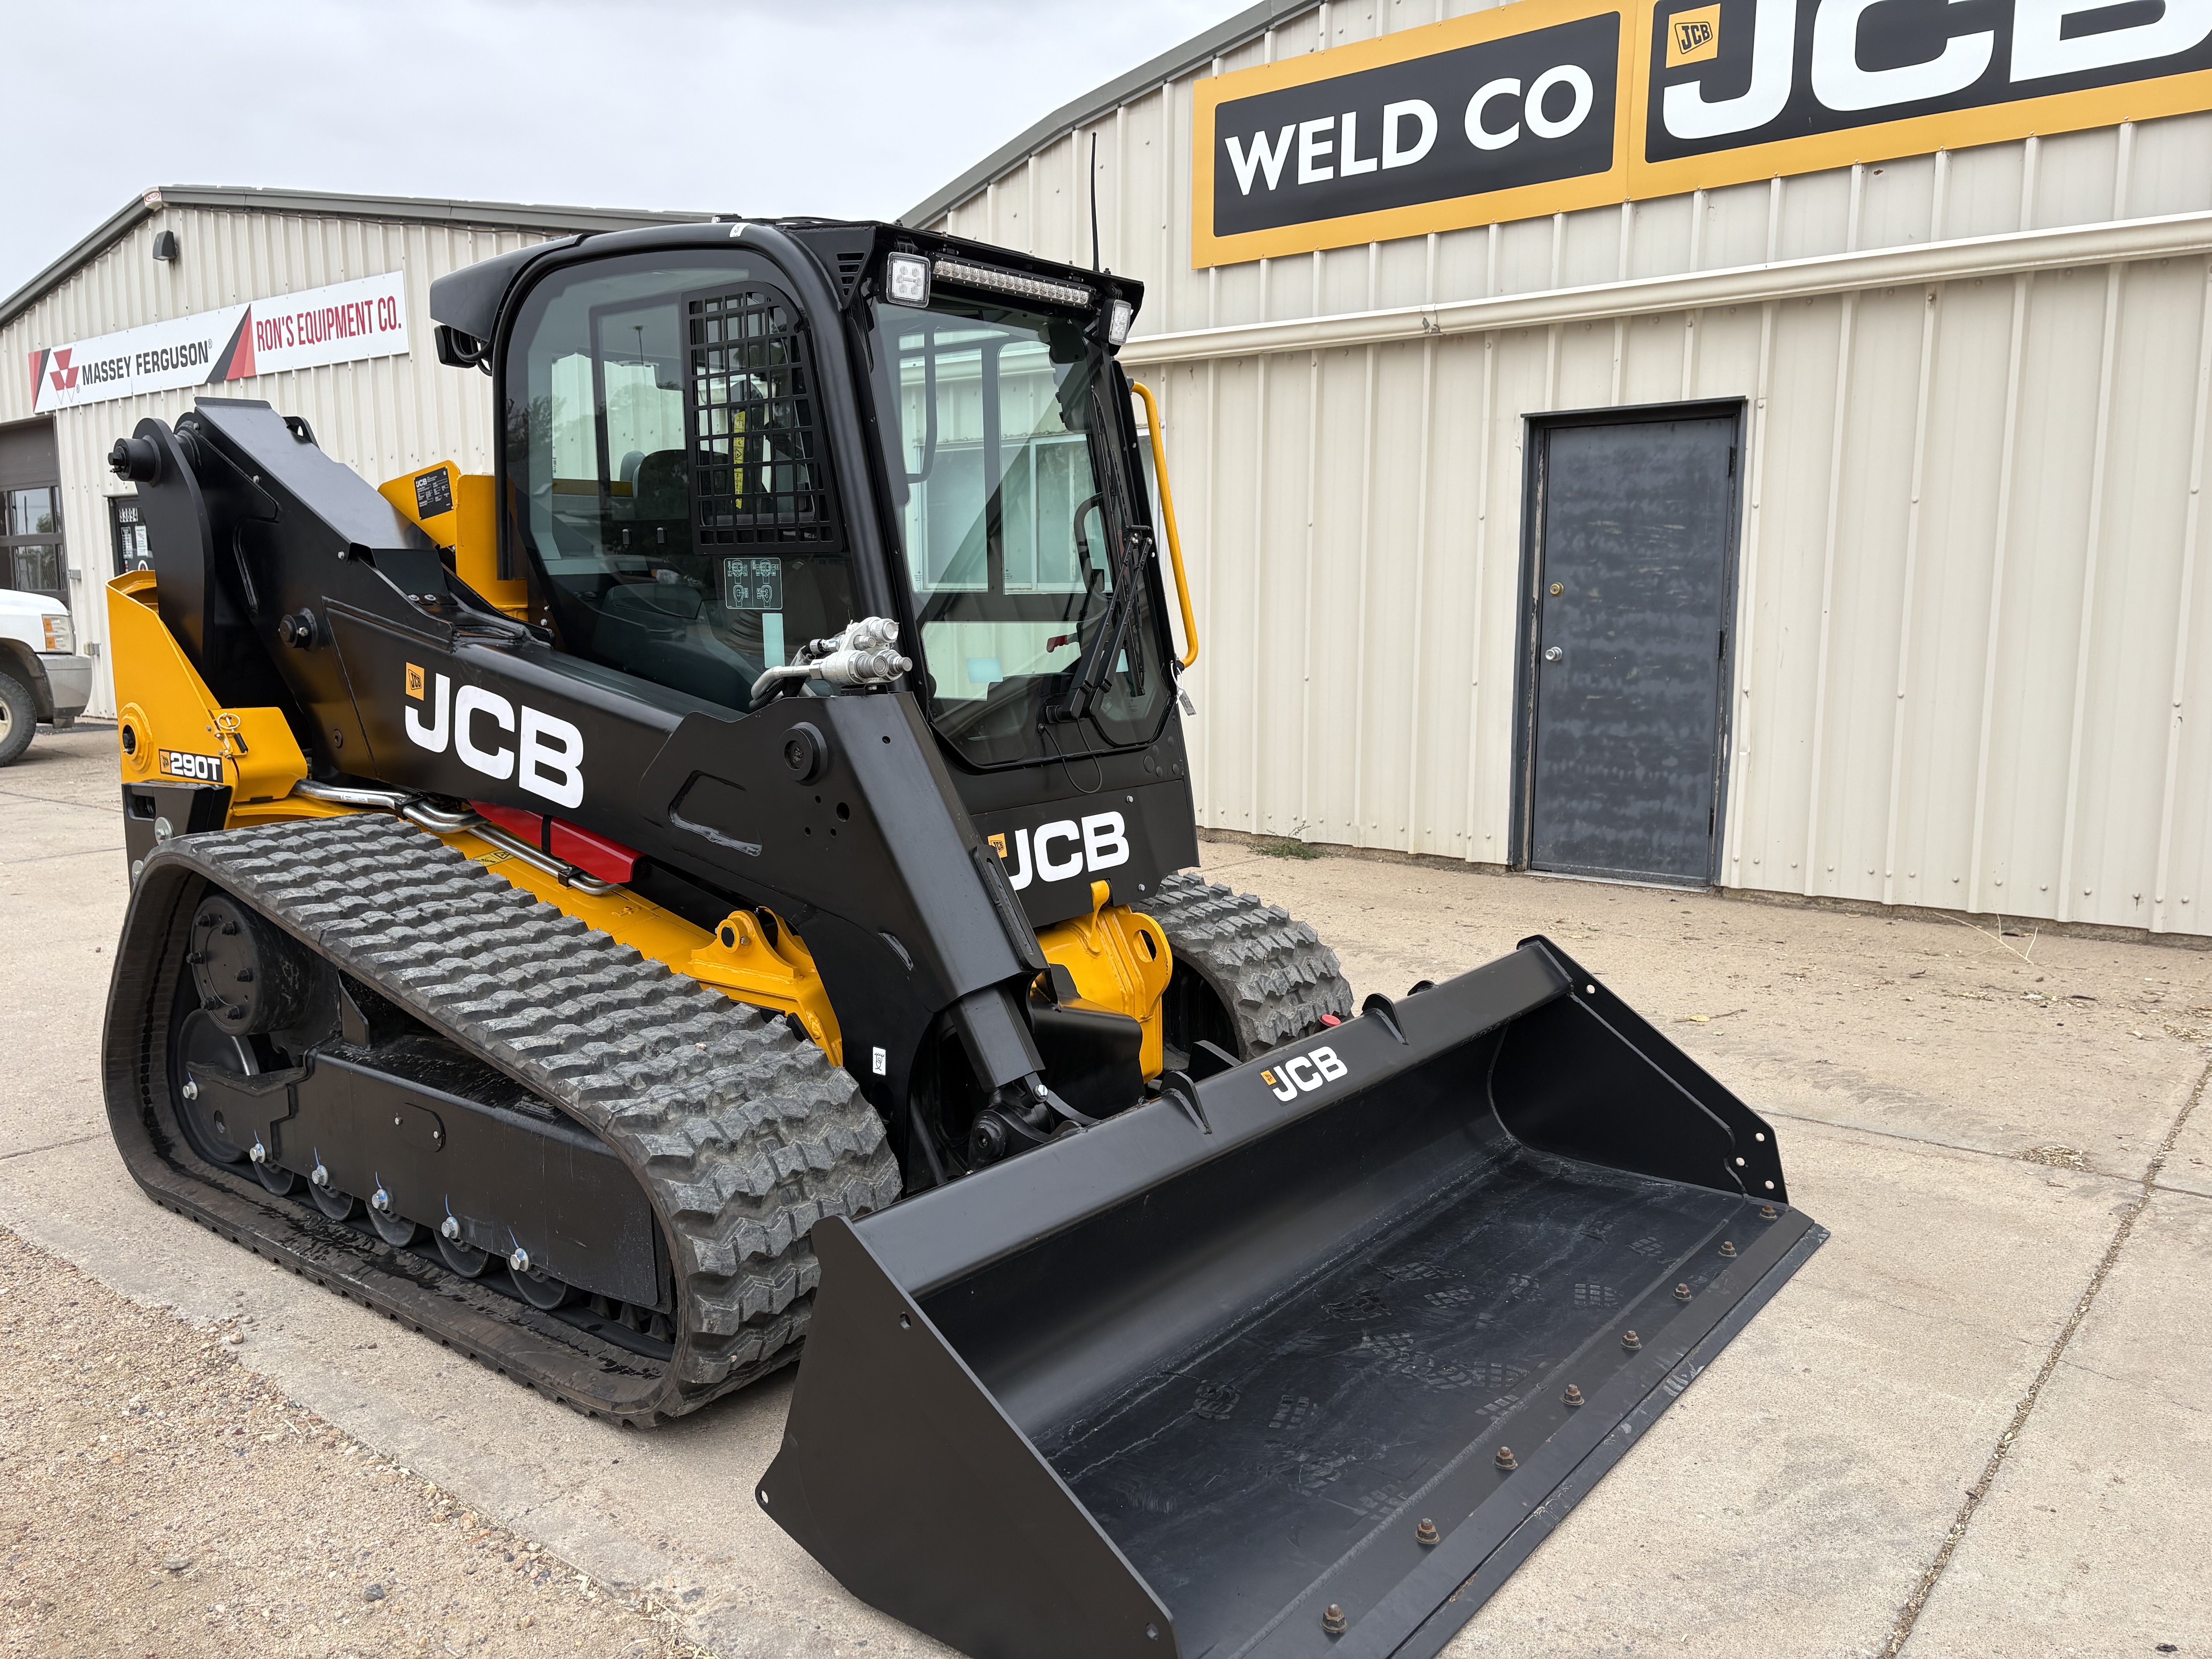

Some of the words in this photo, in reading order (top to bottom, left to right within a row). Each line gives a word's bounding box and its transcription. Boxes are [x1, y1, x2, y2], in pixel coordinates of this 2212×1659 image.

[1681, 24, 1710, 50] JCB
[1225, 99, 1438, 195] WELD
[1464, 64, 1594, 150] CO
[256, 315, 294, 352] RON'S
[297, 299, 373, 345] EQUIPMENT
[378, 295, 401, 331] CO.
[82, 355, 131, 385] MASSEY
[416, 478, 427, 488] JCB
[410, 672, 421, 688] JCB
[405, 673, 584, 808] JCB
[170, 752, 220, 780] 290T
[1009, 811, 1129, 890] JCB
[1272, 1046, 1348, 1101] JCB
